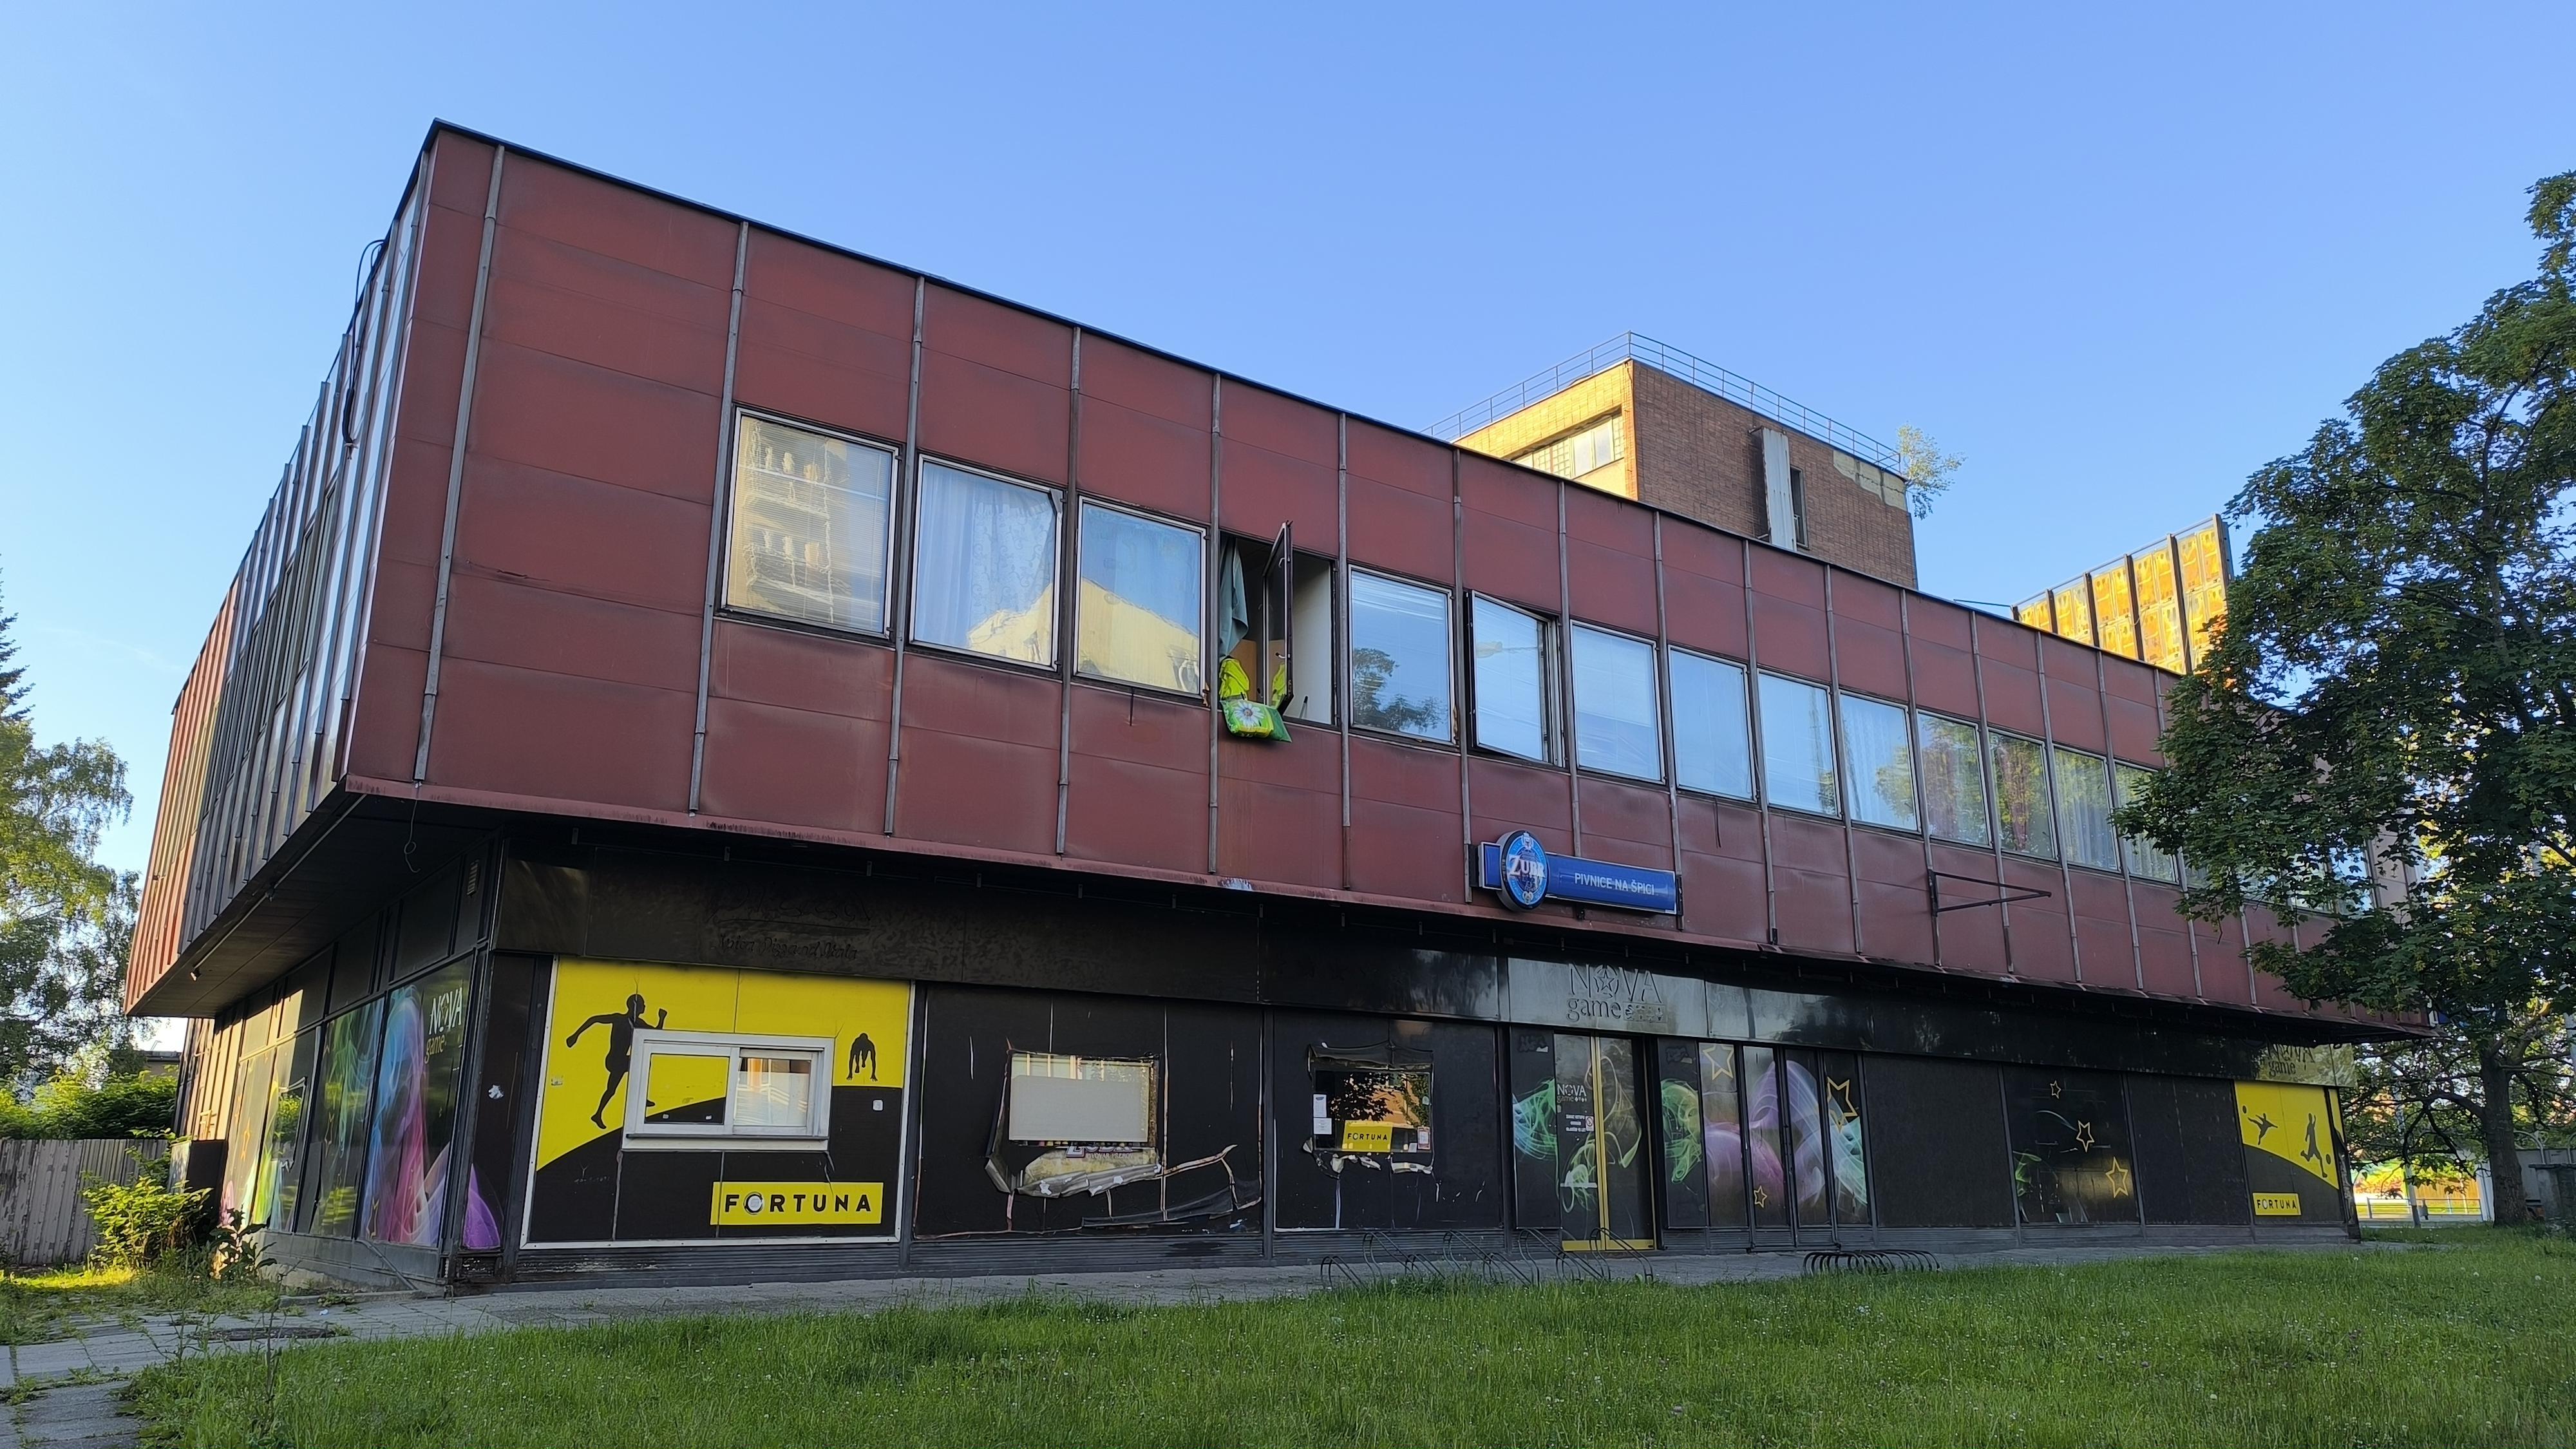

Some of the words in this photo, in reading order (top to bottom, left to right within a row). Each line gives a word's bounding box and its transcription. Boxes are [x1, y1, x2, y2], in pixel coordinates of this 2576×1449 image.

[1508, 854, 1546, 878] ZUBR
[1574, 873, 1613, 889] PIVNICE
[1615, 879, 1629, 891] NA
[1569, 963, 1662, 1003] NOVA
[428, 987, 462, 1035] NOVA
[1567, 999, 1622, 1022] game
[424, 1034, 445, 1064] game
[2269, 1061, 2296, 1077] game
[1557, 1083, 1587, 1097] NOVA
[724, 1192, 871, 1215] FORTUNA
[2257, 1198, 2297, 1209] FORTUNA
